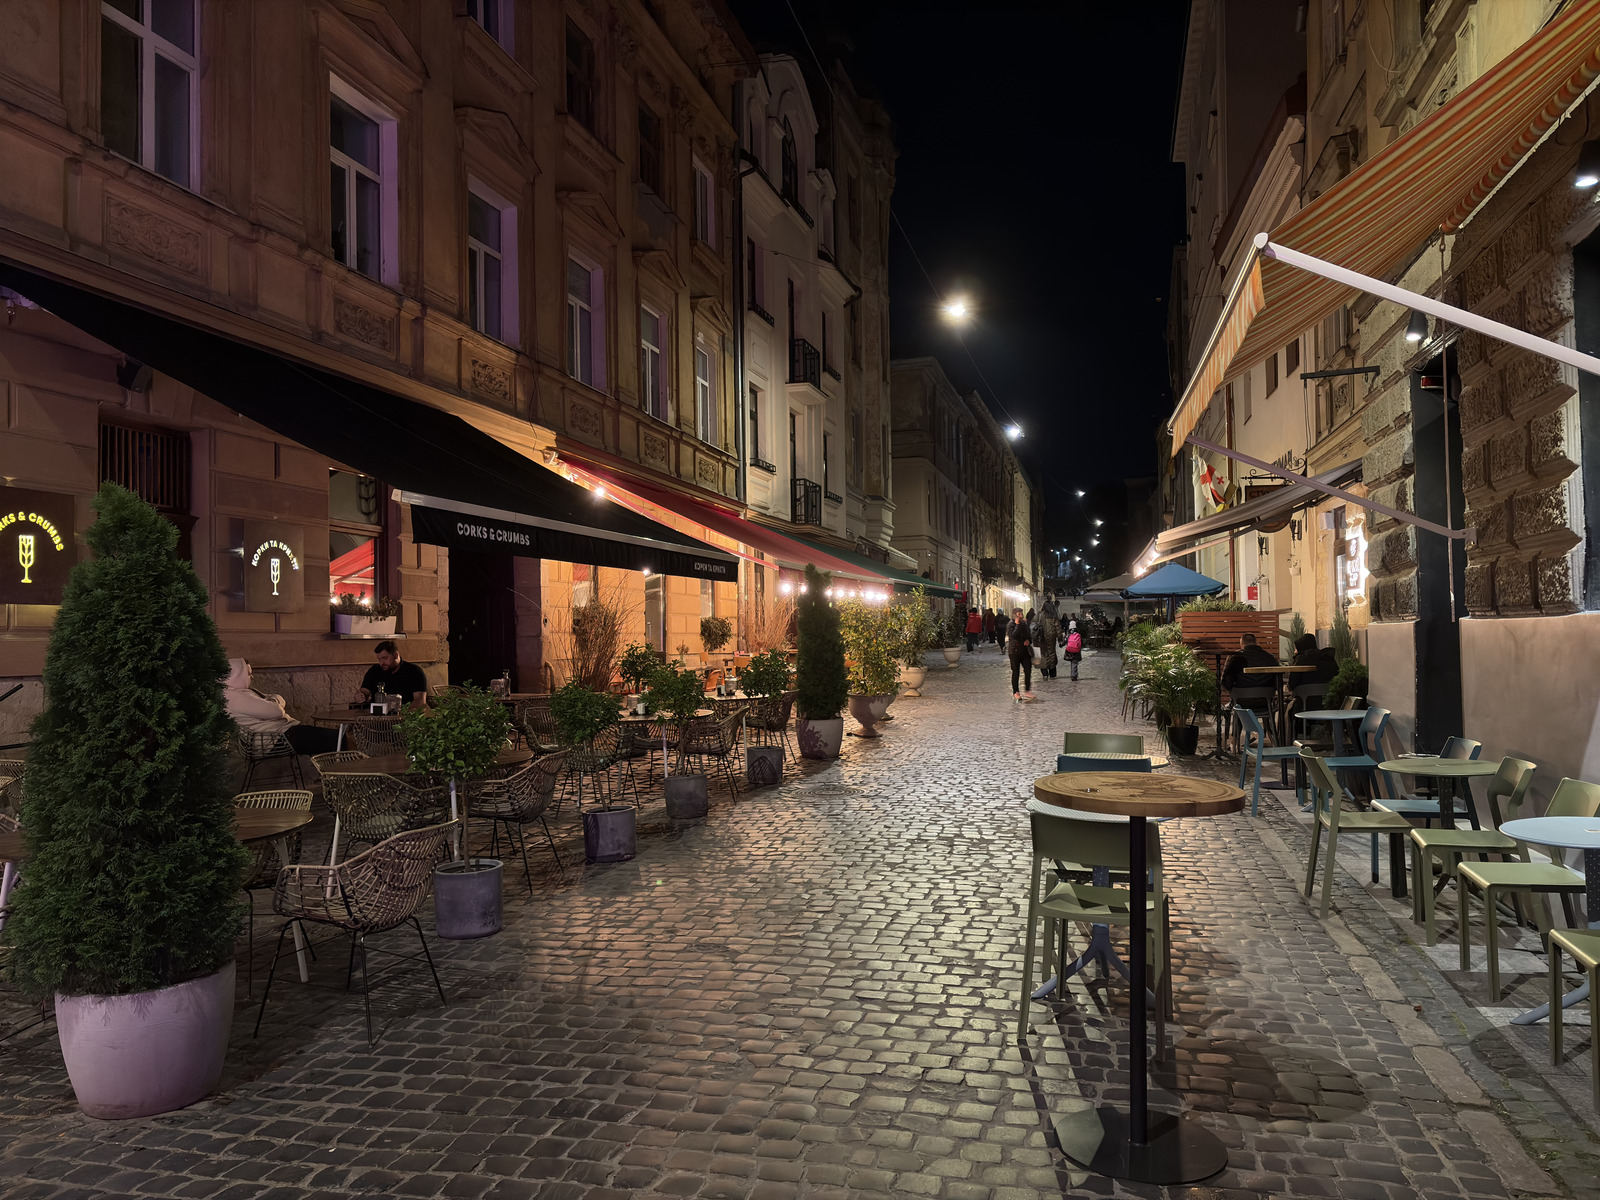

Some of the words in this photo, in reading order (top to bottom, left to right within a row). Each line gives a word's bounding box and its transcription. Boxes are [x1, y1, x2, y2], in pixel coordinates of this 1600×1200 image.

[18, 511, 26, 521] &
[28, 512, 64, 551] CRUMBS
[457, 522, 488, 539] CORKS
[489, 528, 495, 540] &
[496, 529, 530, 546] CRUMBS
[251, 541, 270, 567] КОРКИ
[269, 540, 278, 548] ТА
